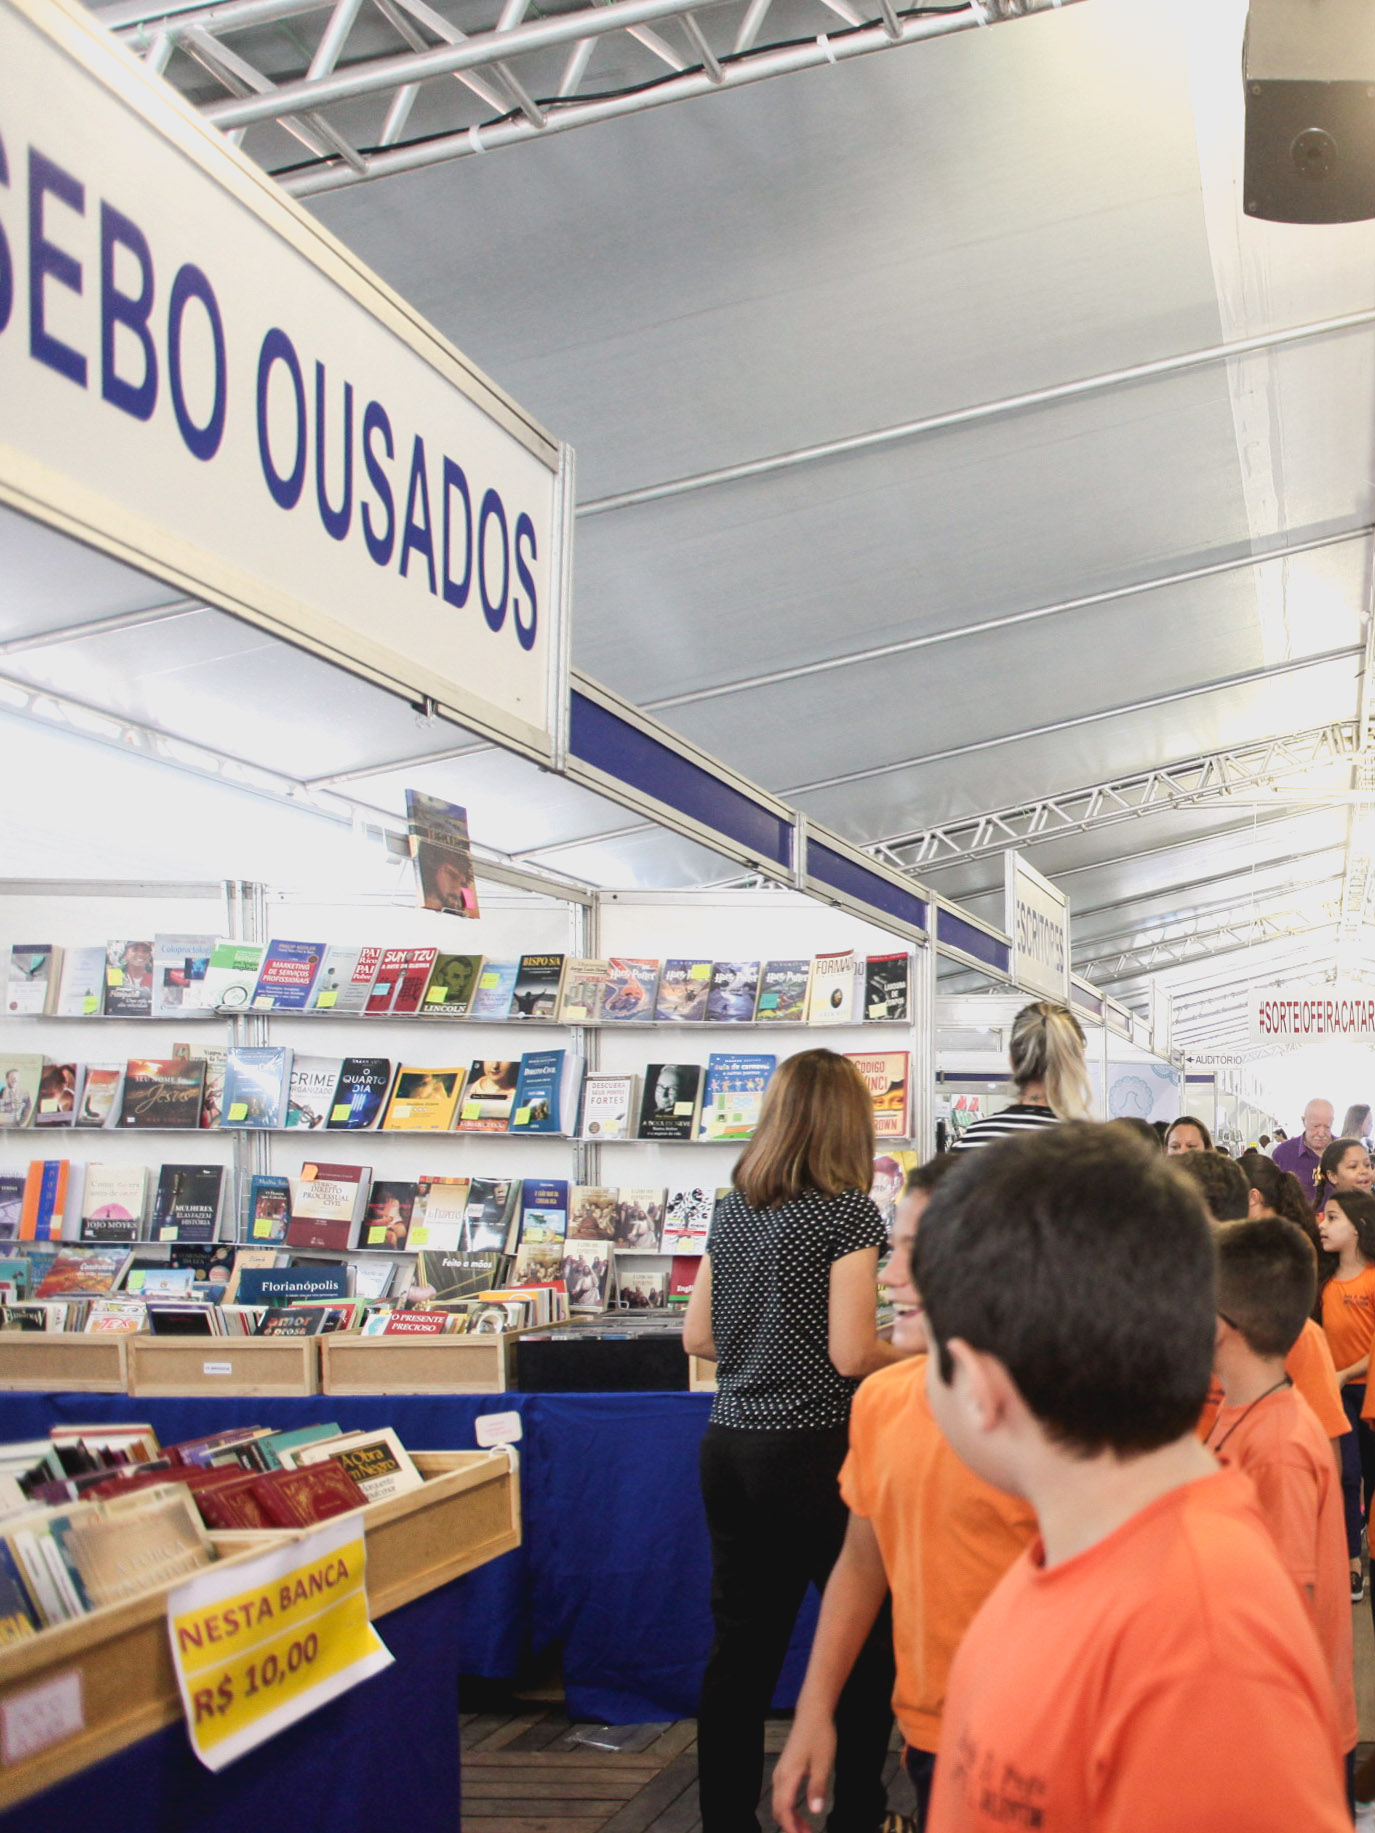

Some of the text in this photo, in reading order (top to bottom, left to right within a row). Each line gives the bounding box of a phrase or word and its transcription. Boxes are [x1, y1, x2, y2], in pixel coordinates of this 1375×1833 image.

[0, 128, 538, 652] EBO OUSADOS
[362, 948, 380, 958] PAI
[384, 950, 435, 963] SUN TZU
[272, 961, 311, 970] MARKETING
[522, 957, 549, 967] BISPO
[355, 964, 375, 974] PAI
[423, 1004, 467, 1013] LINCOLN
[362, 1068, 371, 1076] O
[289, 1071, 337, 1087] CRIME
[342, 1075, 387, 1086] QUARTO
[291, 1086, 334, 1095] RGANIZADO
[351, 1084, 371, 1094] DIA
[590, 1096, 625, 1105] FORTES
[310, 1186, 343, 1194] DIREITO
[302, 1191, 350, 1202] PROCESSUAL
[87, 1221, 138, 1230] JOJO MOYES
[441, 1258, 462, 1268] Feito
[471, 1259, 493, 1269] mãos
[261, 1280, 339, 1293] Florianópolis
[100, 1317, 131, 1330] TEX
[266, 1315, 312, 1328] amor
[400, 1314, 445, 1324] PRESENTE
[390, 1322, 437, 1332] PRECIOSO
[340, 1448, 385, 1467] A Obra
[359, 1458, 396, 1477] Negro
[177, 1557, 349, 1654] NESTA BANCA
[193, 1631, 319, 1725] R$ 10,00
